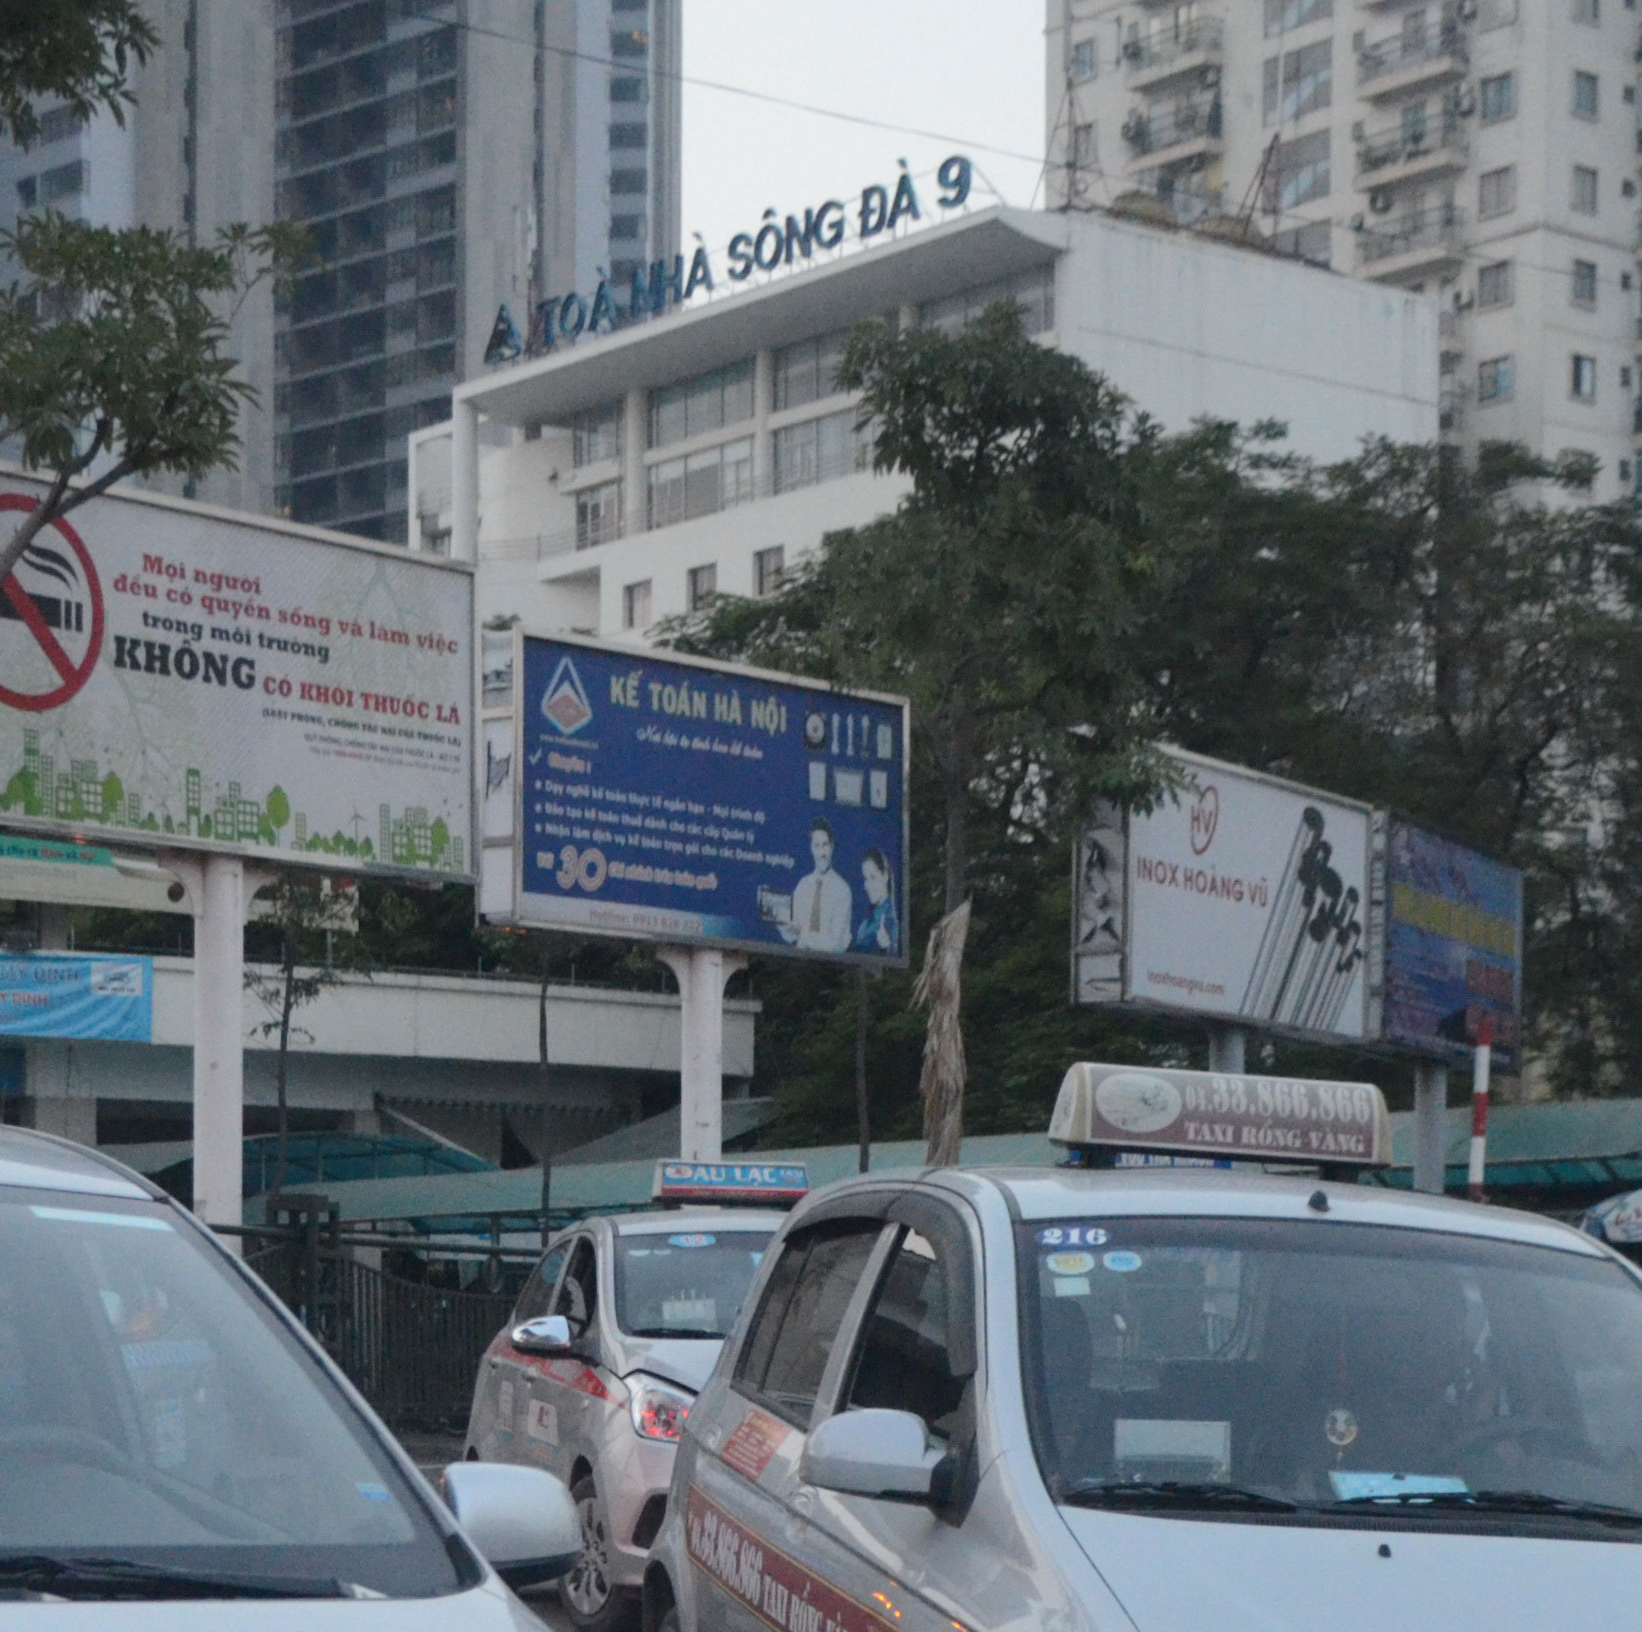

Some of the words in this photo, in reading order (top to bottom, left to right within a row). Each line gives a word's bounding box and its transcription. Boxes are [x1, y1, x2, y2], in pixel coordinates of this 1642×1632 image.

[630, 232, 714, 315] NHÀ
[728, 200, 845, 280] SÔNG
[859, 157, 921, 239] ĐÀ
[938, 154, 973, 207] 9
[141, 553, 186, 581] Mọi
[192, 564, 262, 596] người
[113, 572, 158, 599] đều
[166, 585, 193, 606] có
[200, 593, 271, 622] quyền
[277, 606, 331, 638] sống
[337, 616, 364, 638] và
[369, 621, 411, 646] làm
[416, 628, 459, 656] việc
[141, 611, 204, 640] trong
[209, 621, 253, 647] môi
[257, 631, 331, 664] trường
[113, 637, 257, 690] KHÔNG
[262, 671, 293, 700] CÓ
[299, 676, 355, 710] KHÓI
[360, 688, 431, 722] THUỐC
[435, 700, 461, 726] LÁ
[610, 669, 644, 709] KẾ
[648, 681, 707, 720] TOÁN
[714, 690, 743, 724] HÀ
[750, 696, 787, 736] NỘI
[1191, 805, 1214, 836] HV
[556, 845, 607, 892] 30
[1137, 857, 1180, 889] INOX
[1183, 864, 1246, 902] HOÀNG
[1249, 877, 1269, 908] VŨ
[1184, 1121, 1233, 1145] TAXI
[1042, 1227, 1108, 1246] 216
